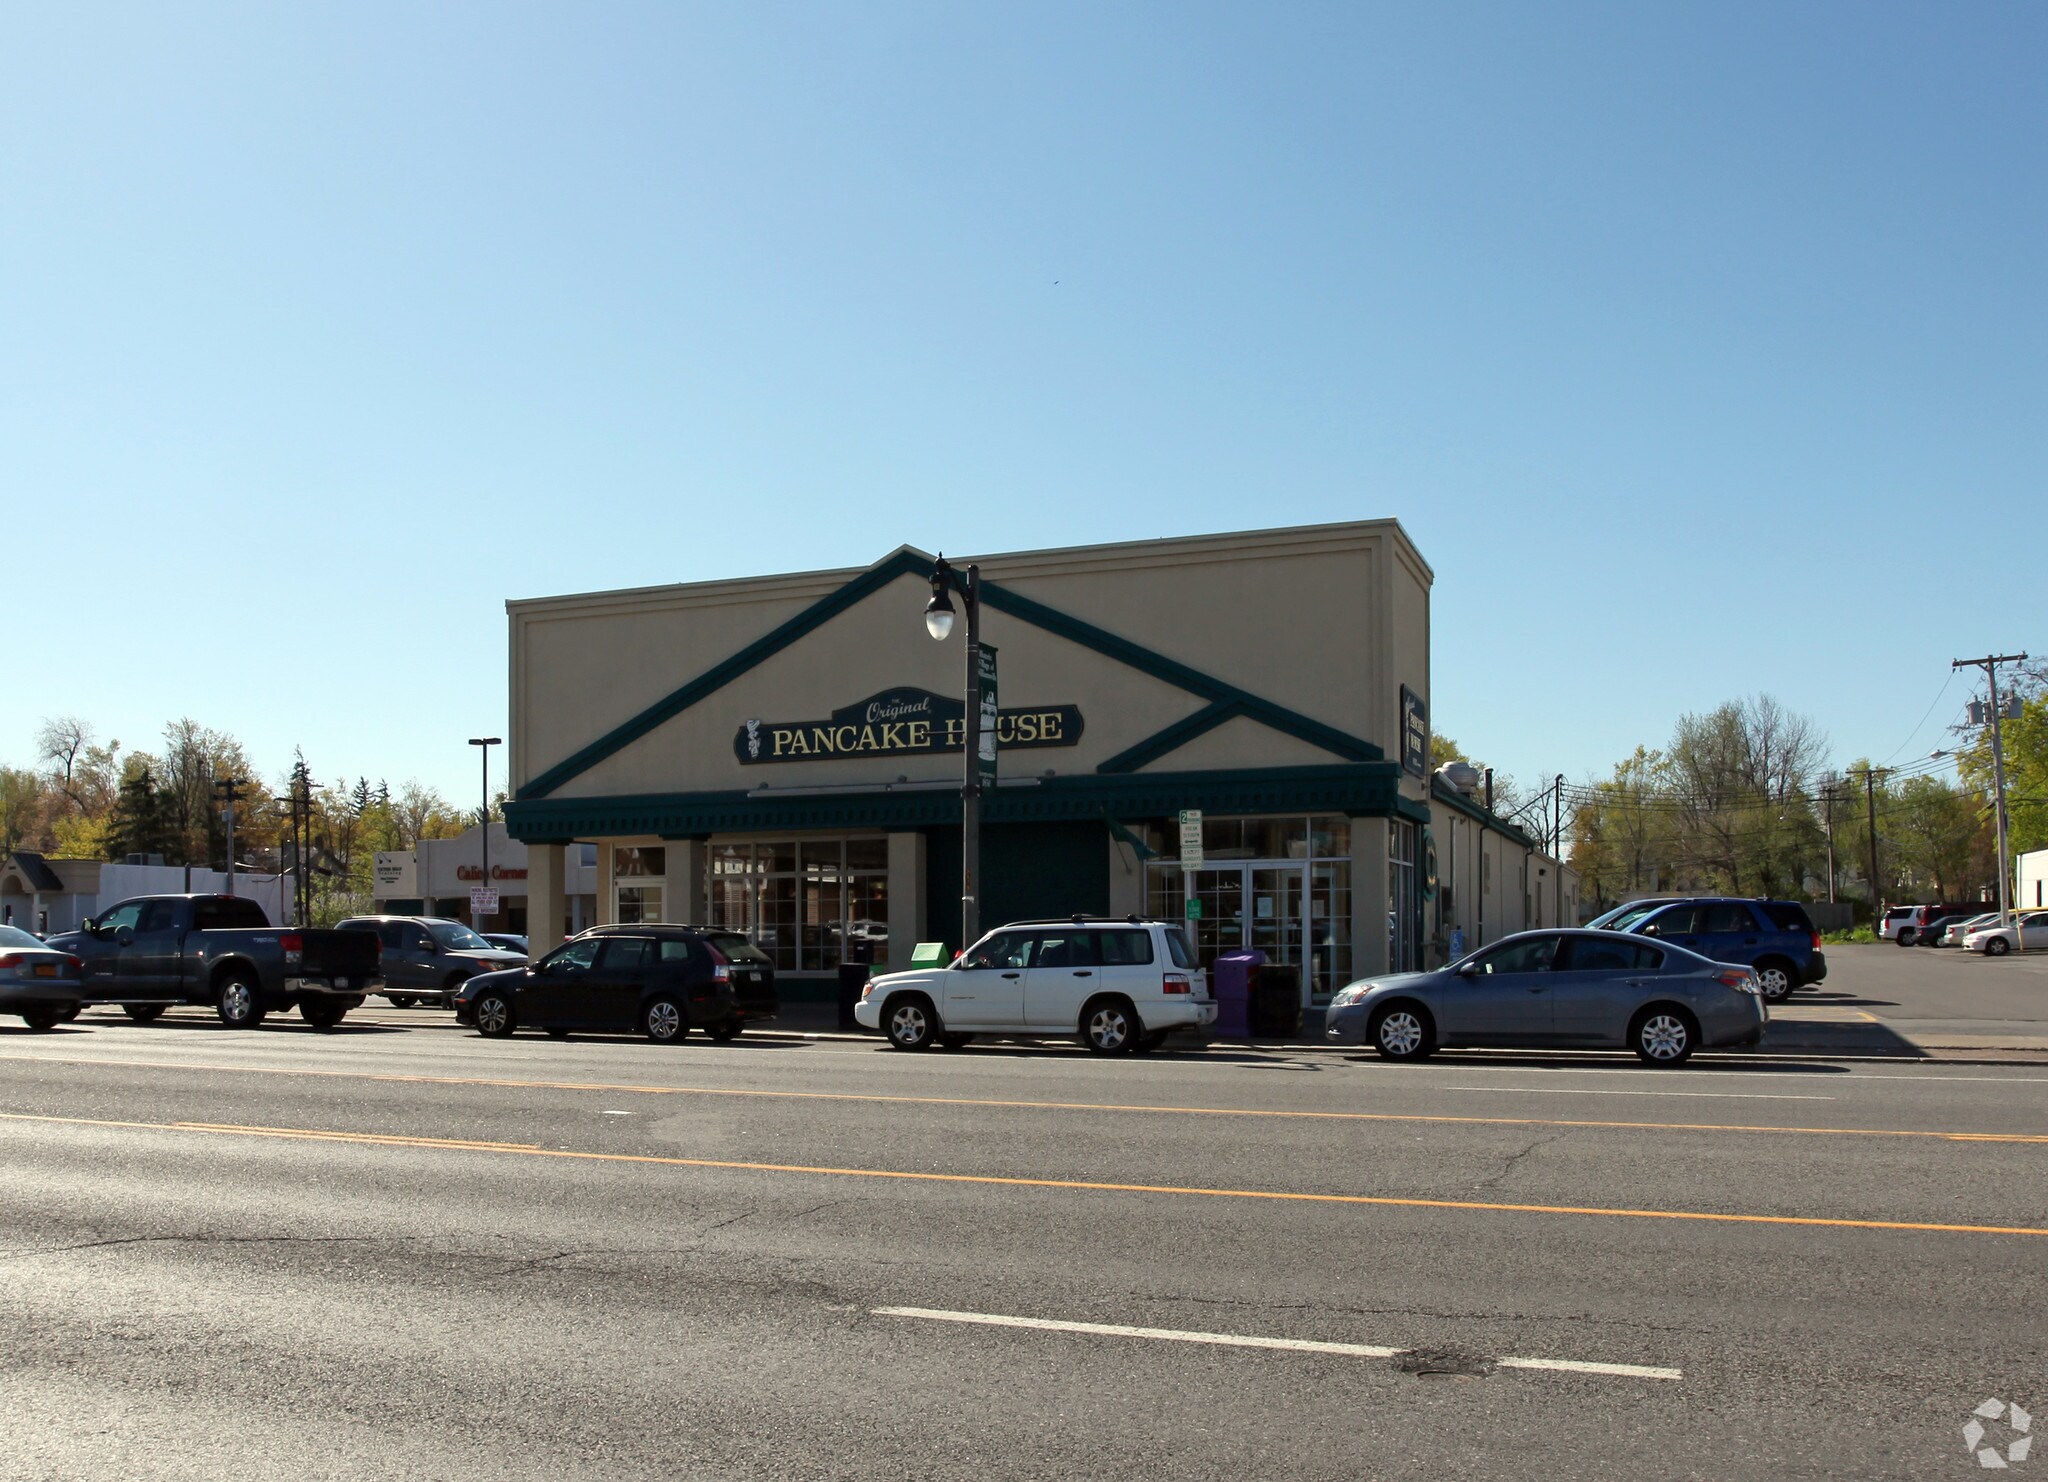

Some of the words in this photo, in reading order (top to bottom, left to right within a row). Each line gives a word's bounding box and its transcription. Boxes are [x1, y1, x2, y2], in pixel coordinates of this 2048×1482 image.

[866, 697, 930, 723] Original
[772, 720, 931, 756] PANCAKE
[945, 712, 1063, 746] HUSE
[1181, 812, 1187, 823] 2
